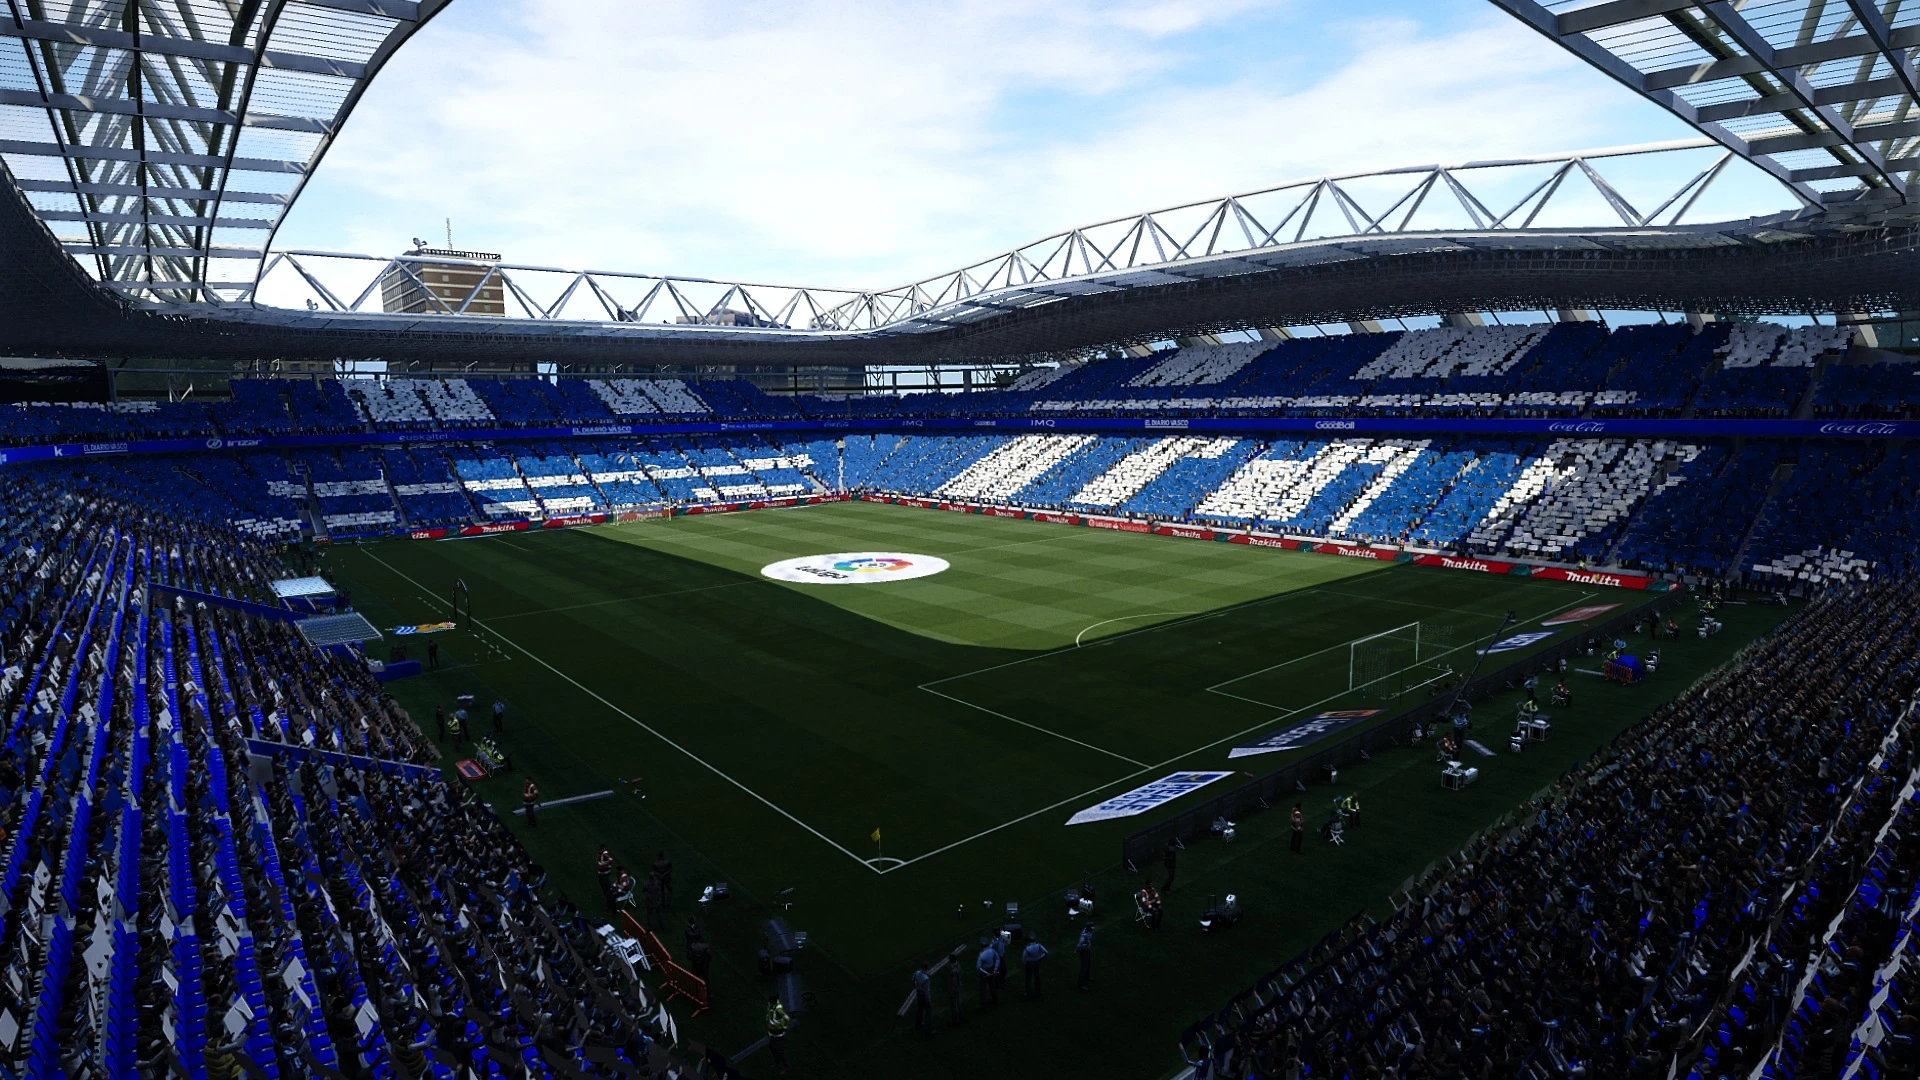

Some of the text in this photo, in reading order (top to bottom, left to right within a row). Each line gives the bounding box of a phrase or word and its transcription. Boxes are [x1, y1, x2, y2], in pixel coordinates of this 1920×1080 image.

[398, 433, 448, 441] euskaltel
[90, 443, 110, 451] DIARIO
[110, 442, 128, 450] VASCO
